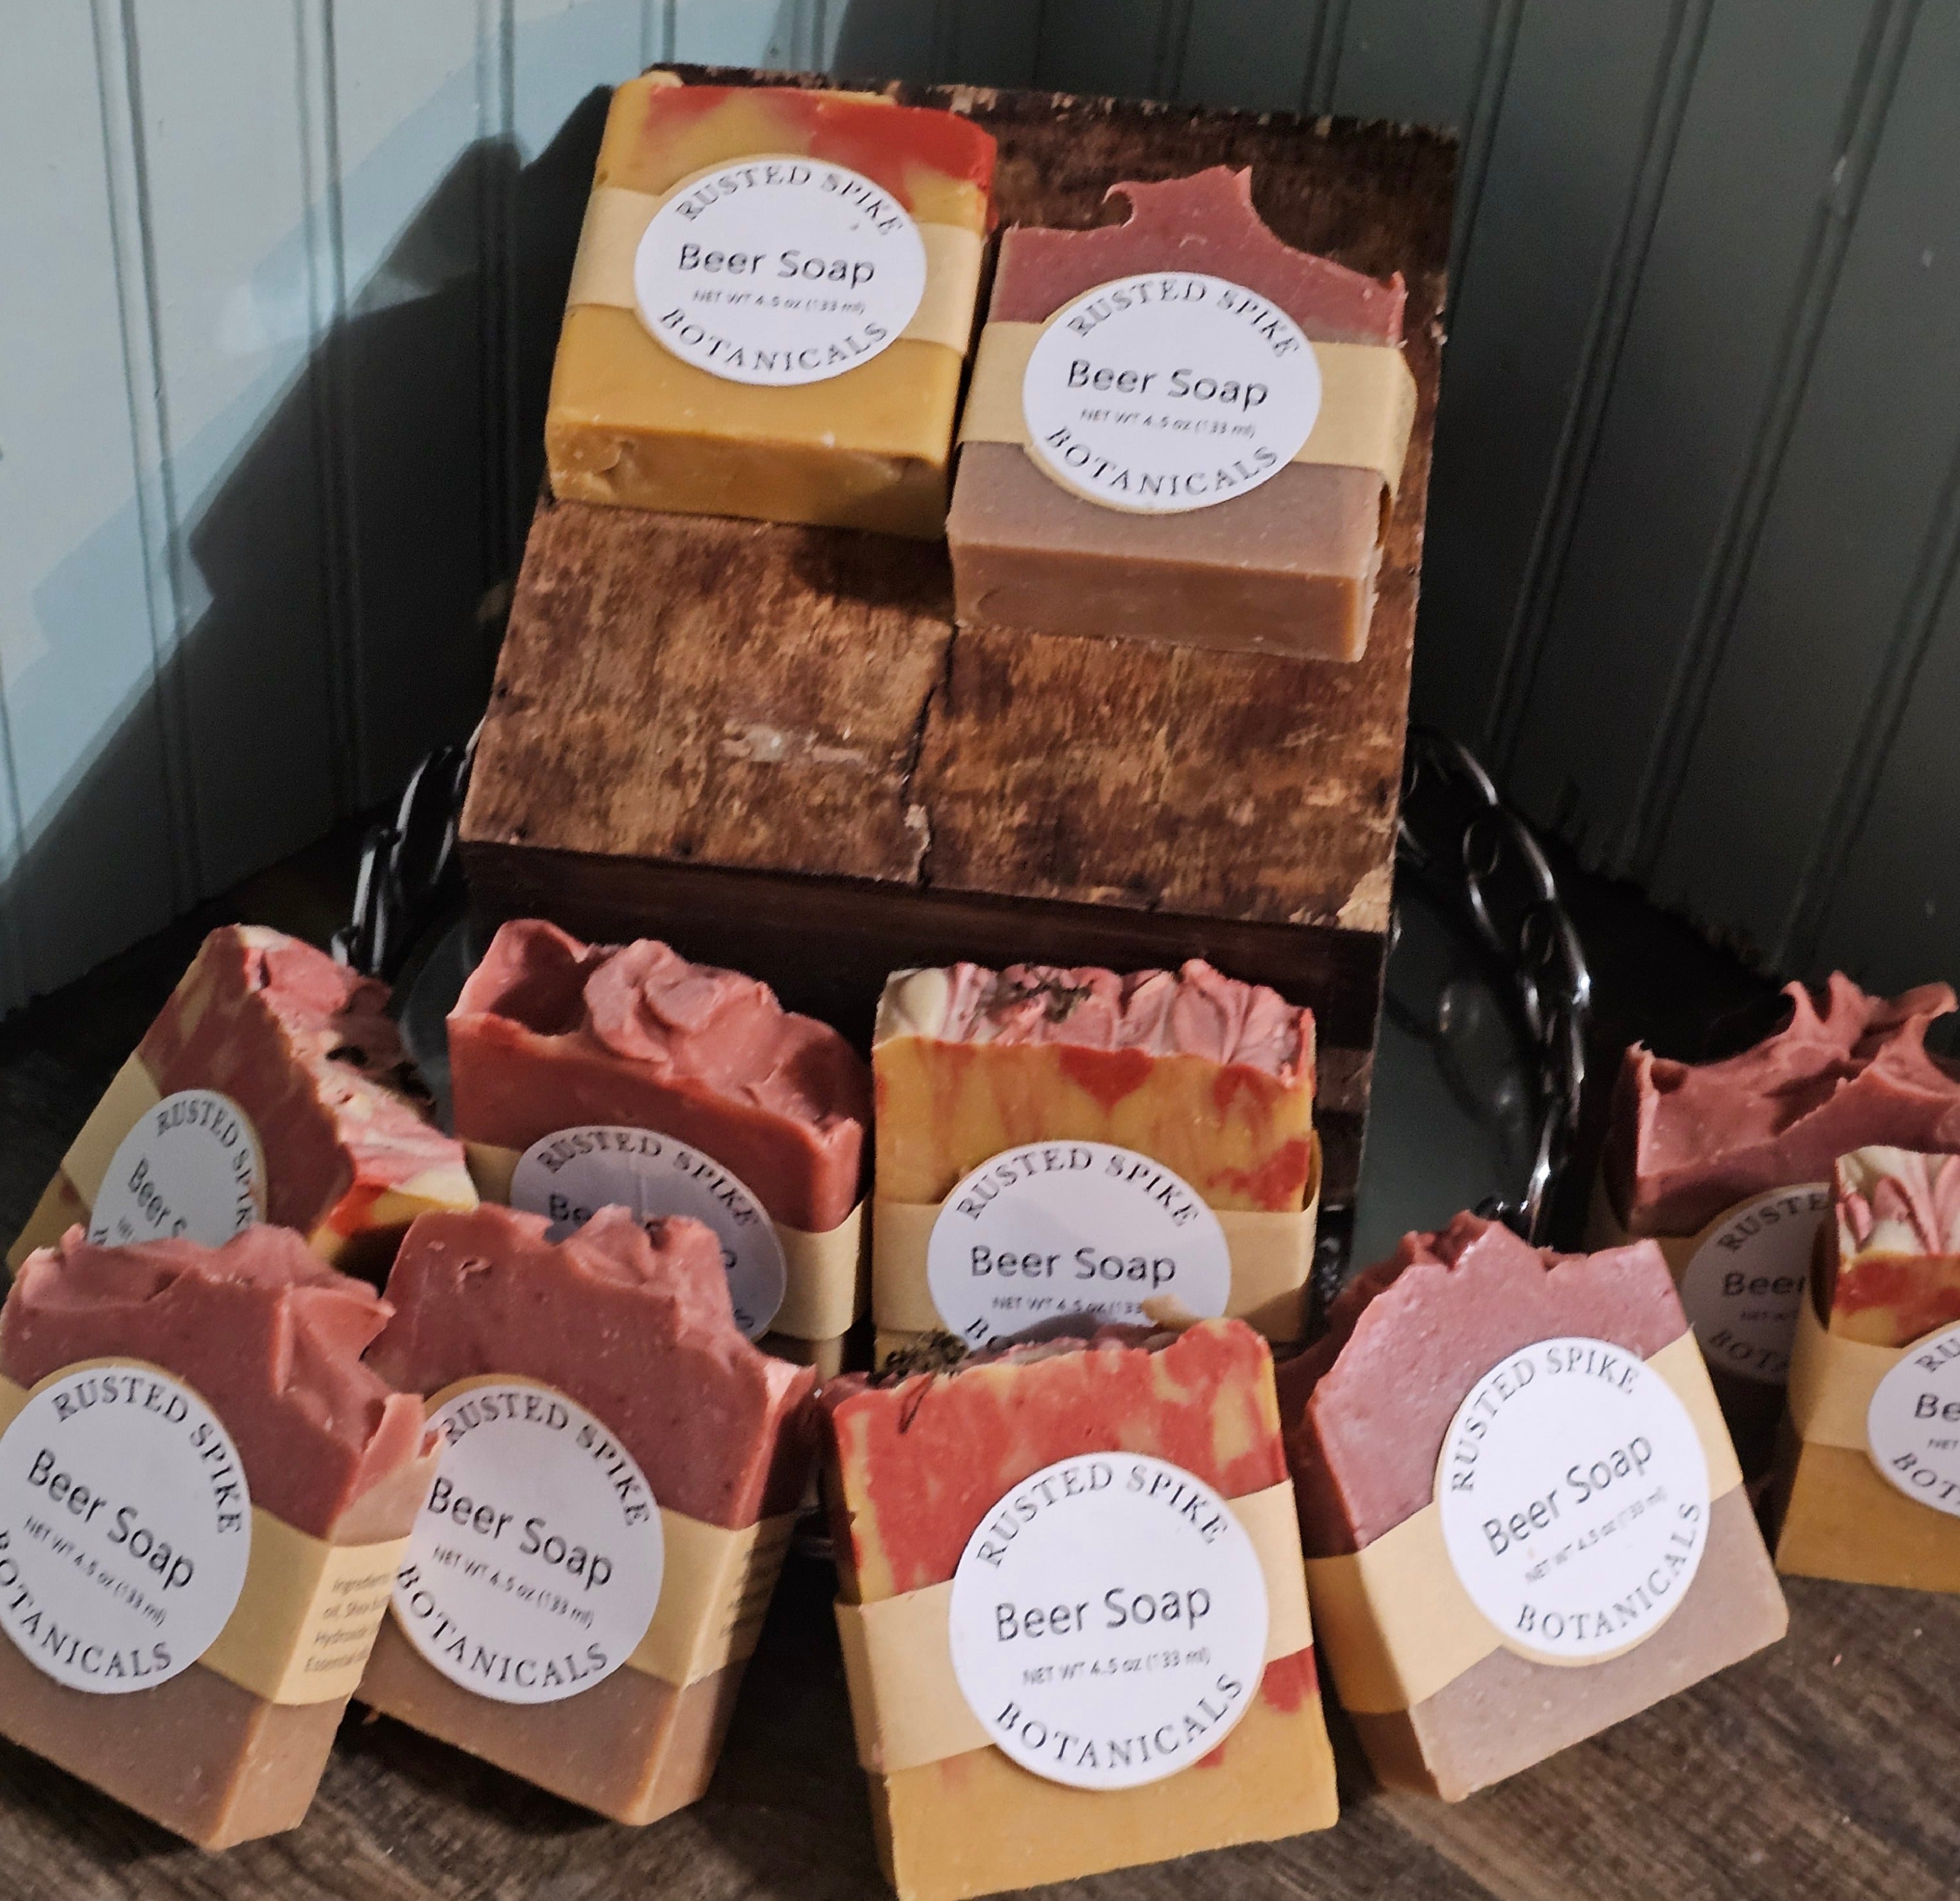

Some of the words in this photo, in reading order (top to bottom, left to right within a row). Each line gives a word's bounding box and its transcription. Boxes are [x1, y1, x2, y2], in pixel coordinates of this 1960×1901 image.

[676, 165, 811, 221] RUSTED
[821, 173, 903, 236] SPIKE
[678, 242, 767, 274] Beer
[777, 249, 875, 289] Soap
[693, 289, 721, 302] NET
[784, 299, 802, 308] oz
[659, 307, 888, 372] BOTANICALS
[1066, 279, 1208, 338] RUSTED
[1217, 289, 1301, 358] SPIKE
[1066, 359, 1158, 393] Beer
[1168, 368, 1269, 412] Soap
[1081, 408, 1111, 421] NET
[1173, 420, 1191, 430] oz
[1046, 425, 1279, 496] BOTANICALS
[156, 1097, 239, 1148] RUSTED
[128, 1157, 171, 1228] Beer
[536, 1131, 662, 1173] RUSTED
[673, 1151, 760, 1226] SPIKE
[956, 1147, 1093, 1220] RUSTED
[1105, 1154, 1200, 1227] SPIKE
[970, 1245, 1061, 1278] Beer
[1074, 1246, 1175, 1289] Soap
[51, 1375, 189, 1424] RUSTED
[189, 1422, 243, 1535] SPIKE
[1451, 1357, 1537, 1492] RUSTED
[1546, 1346, 1639, 1395] SPIKE
[440, 1392, 570, 1448] RUSTED
[576, 1423, 651, 1529] SPIKE
[1481, 1488, 1560, 1557] Beer
[1565, 1435, 1653, 1504] Soap
[27, 1447, 107, 1524] Beer
[106, 1505, 195, 1591] Soap
[426, 1475, 515, 1540] Beer
[519, 1517, 613, 1591] Soap
[976, 1461, 1113, 1569] RUSTED
[1125, 1464, 1229, 1545] SPIKE
[517, 1584, 536, 1600] oz
[1515, 1501, 1701, 1641] BOTANICALS
[395, 1564, 608, 1689] BOTANICALS
[996, 1600, 1090, 1642] Beer
[1103, 1587, 1211, 1631] Soap
[1122, 1657, 1142, 1672] oz
[994, 1672, 1243, 1770] BOTANICALS
